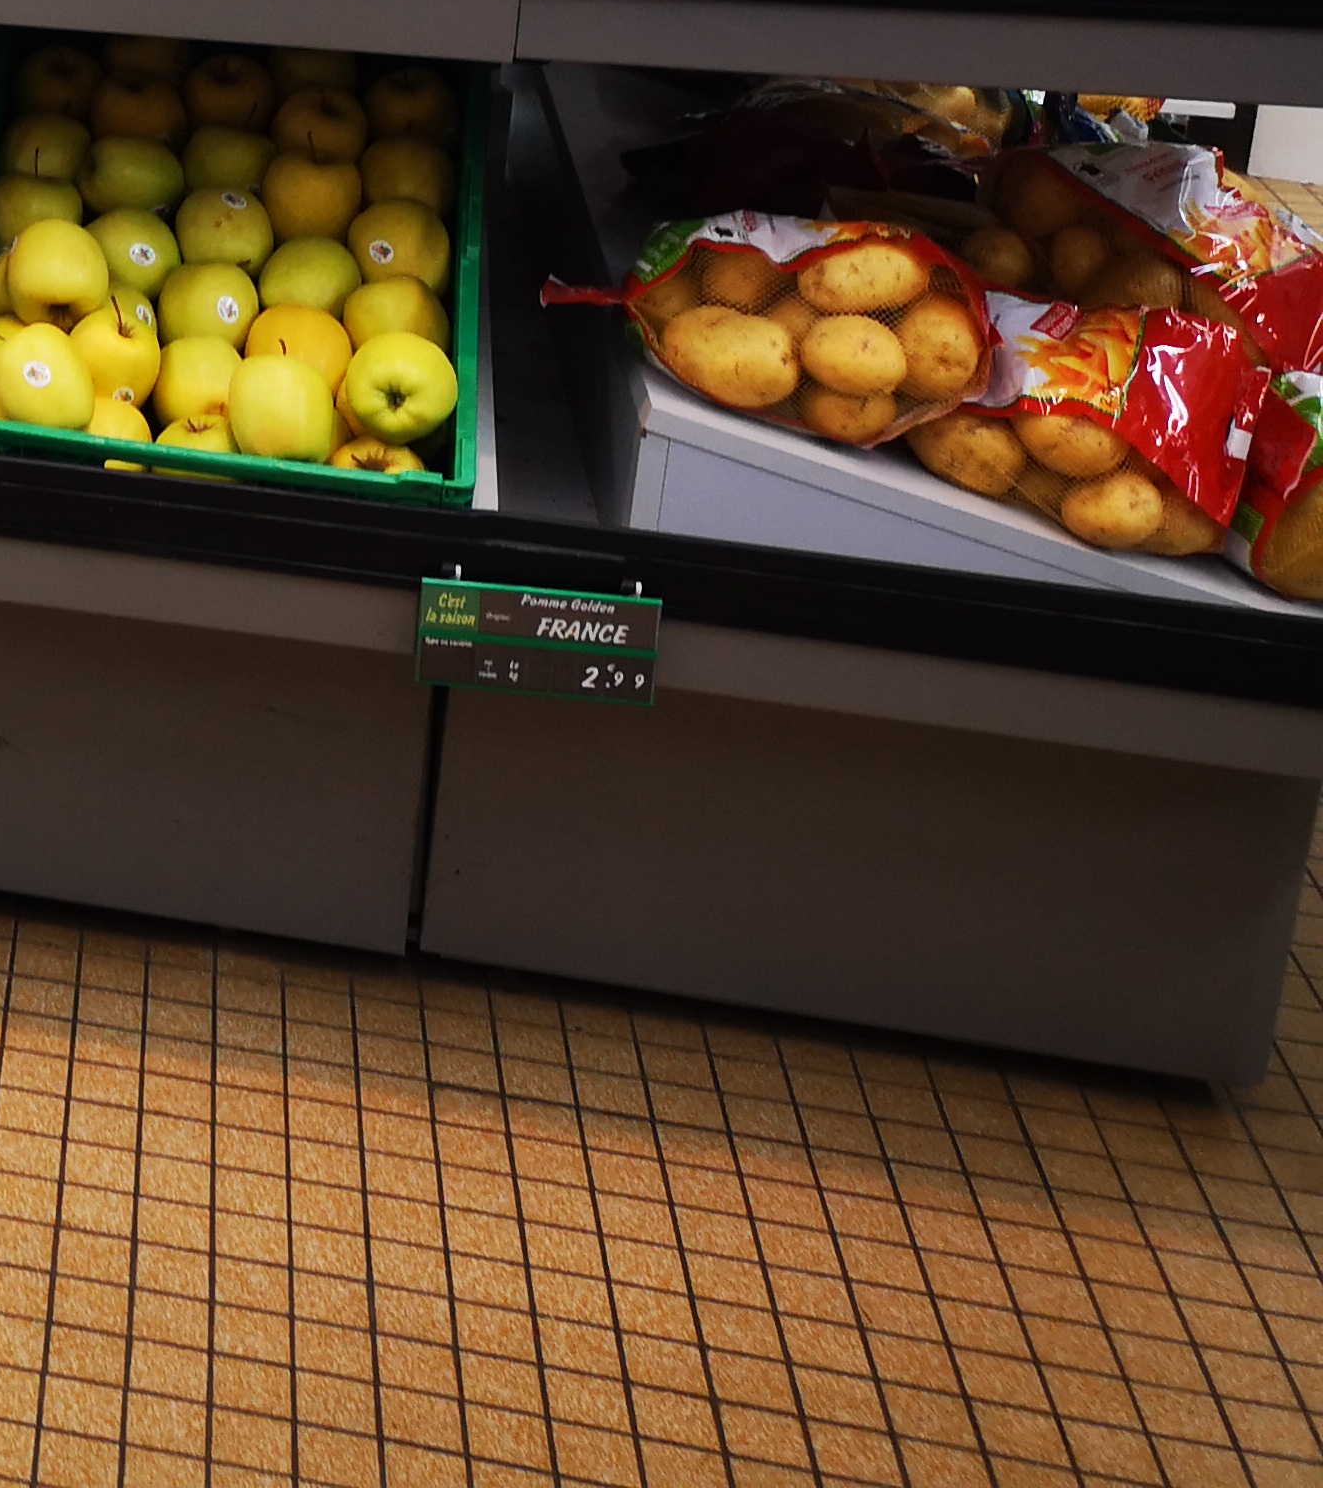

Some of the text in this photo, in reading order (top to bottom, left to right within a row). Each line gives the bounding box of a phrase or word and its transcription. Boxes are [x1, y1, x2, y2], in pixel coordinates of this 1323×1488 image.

[438, 592, 467, 610] C'est
[521, 593, 616, 615] Pomme Golden
[426, 607, 476, 627] la saison
[536, 616, 630, 645] FRANCE
